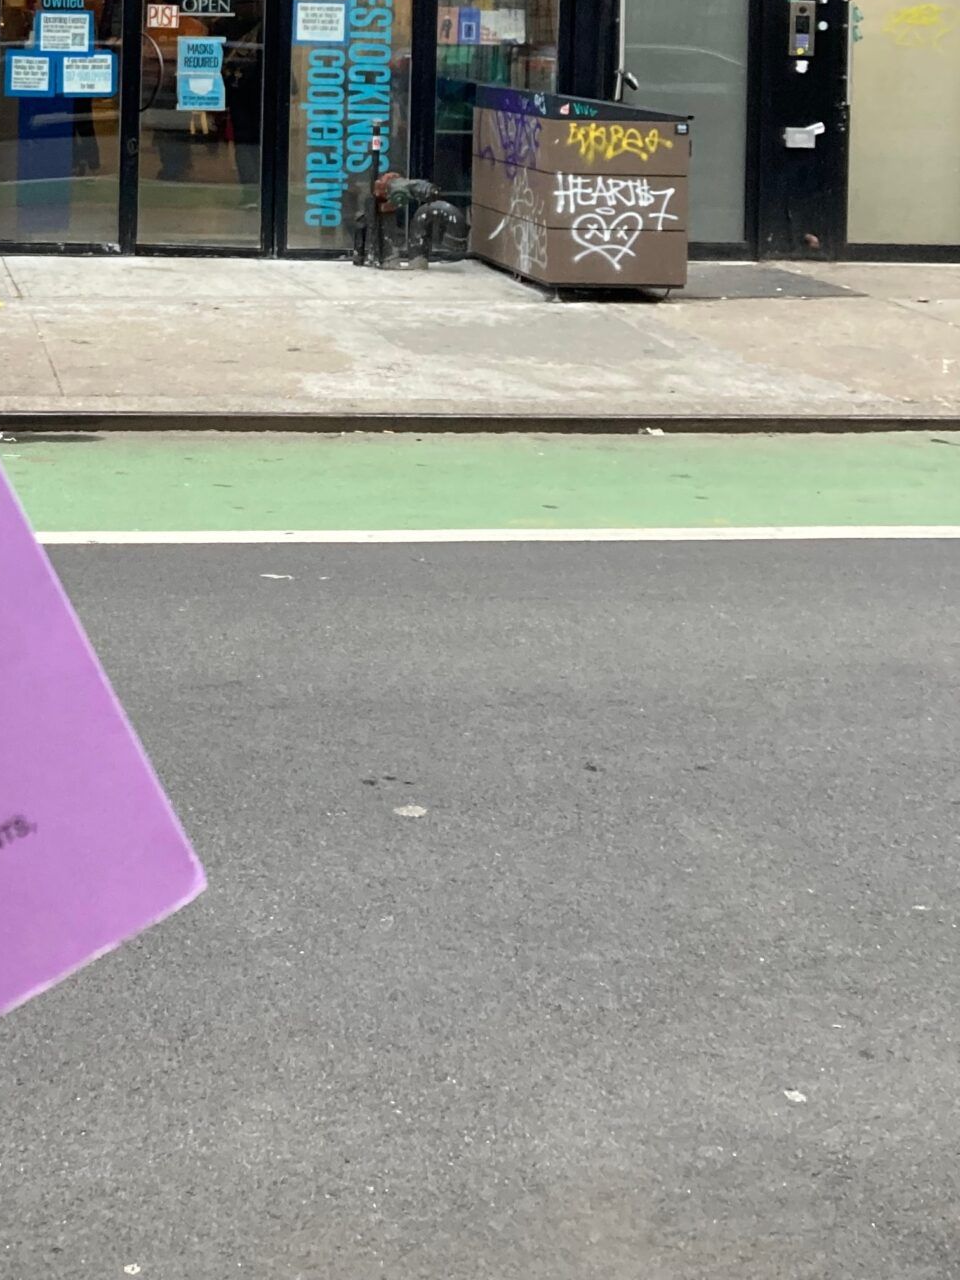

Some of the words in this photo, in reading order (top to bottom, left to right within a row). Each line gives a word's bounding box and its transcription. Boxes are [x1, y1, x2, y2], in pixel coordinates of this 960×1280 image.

[148, 5, 179, 28] PUSH
[187, 43, 214, 56] MASKS
[183, 56, 219, 69] REQUIRED
